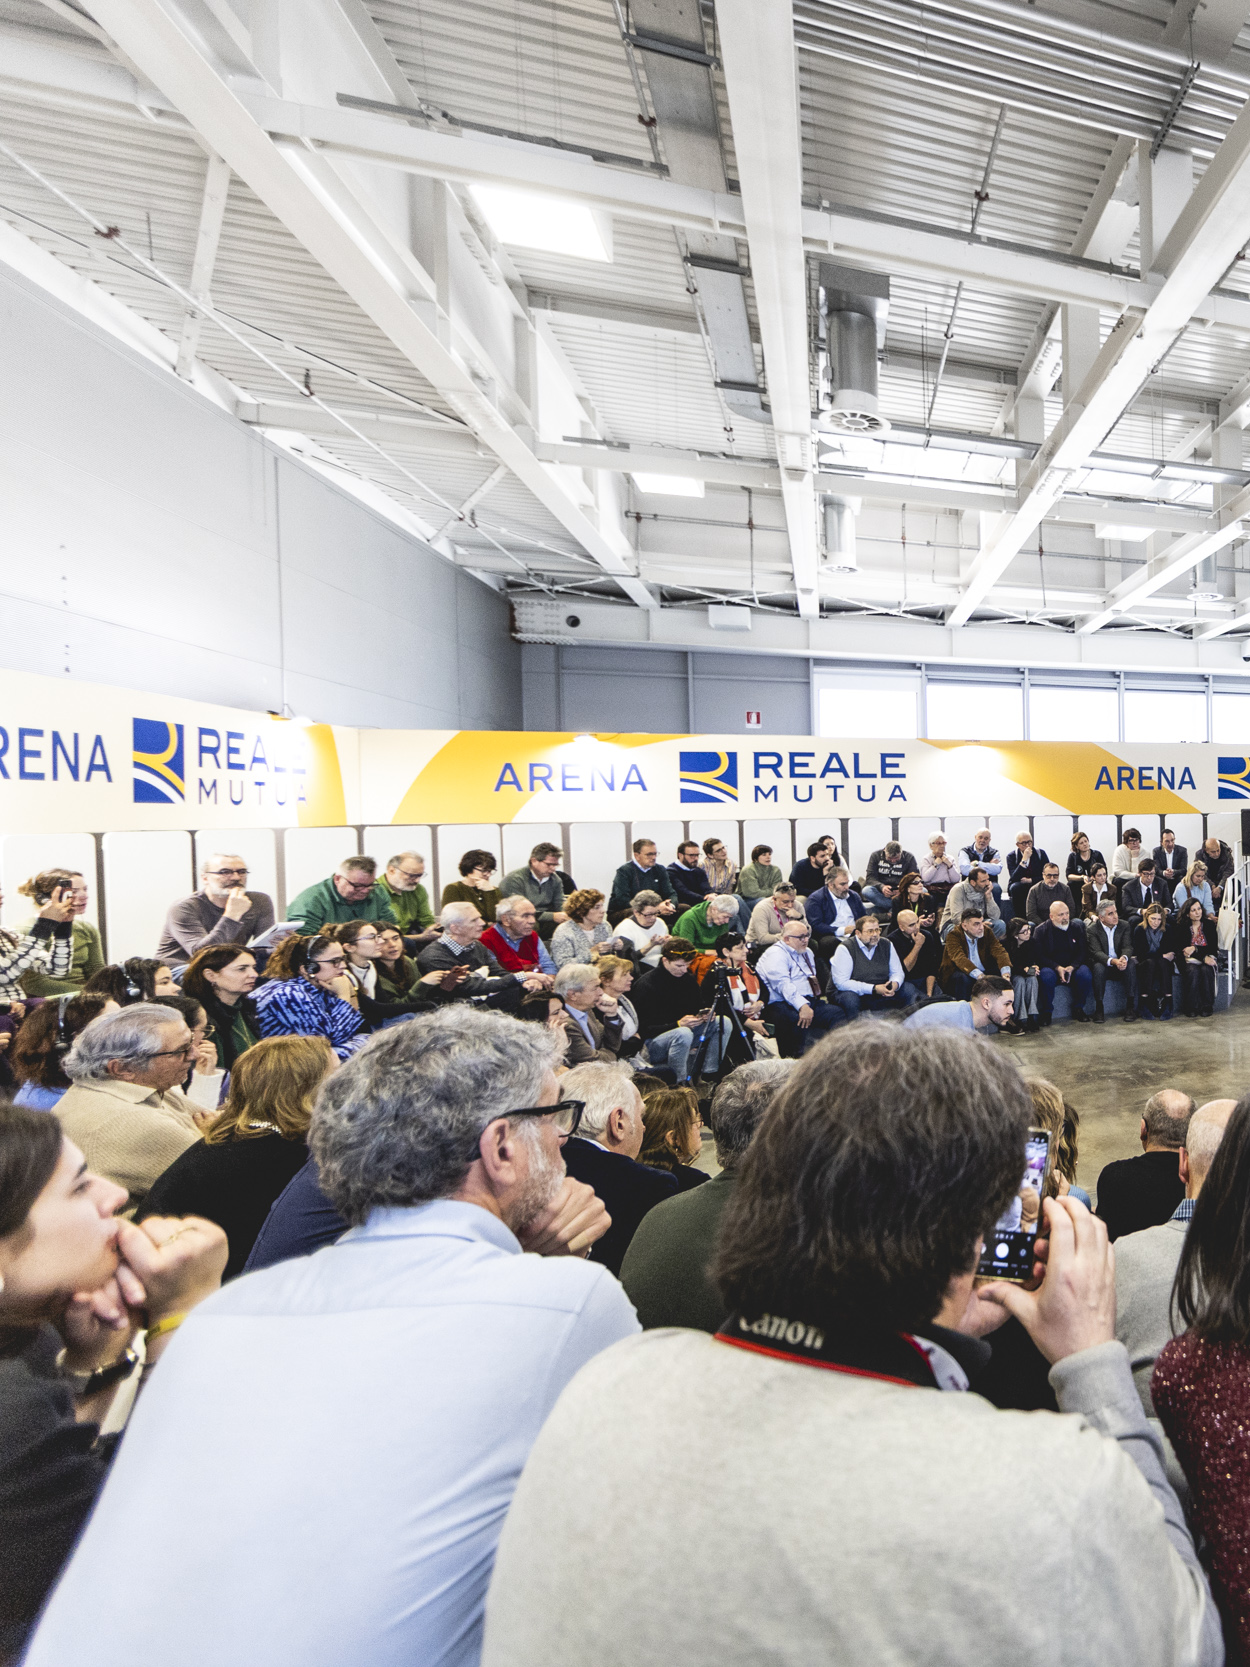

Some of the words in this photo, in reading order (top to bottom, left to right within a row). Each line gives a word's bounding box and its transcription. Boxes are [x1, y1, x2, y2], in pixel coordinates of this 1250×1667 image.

[493, 762, 649, 793] ARENA
[752, 751, 907, 779] REALE
[1094, 766, 1197, 791] ARENA
[198, 777, 308, 806] MUTUA
[753, 784, 908, 803] MUTUA
